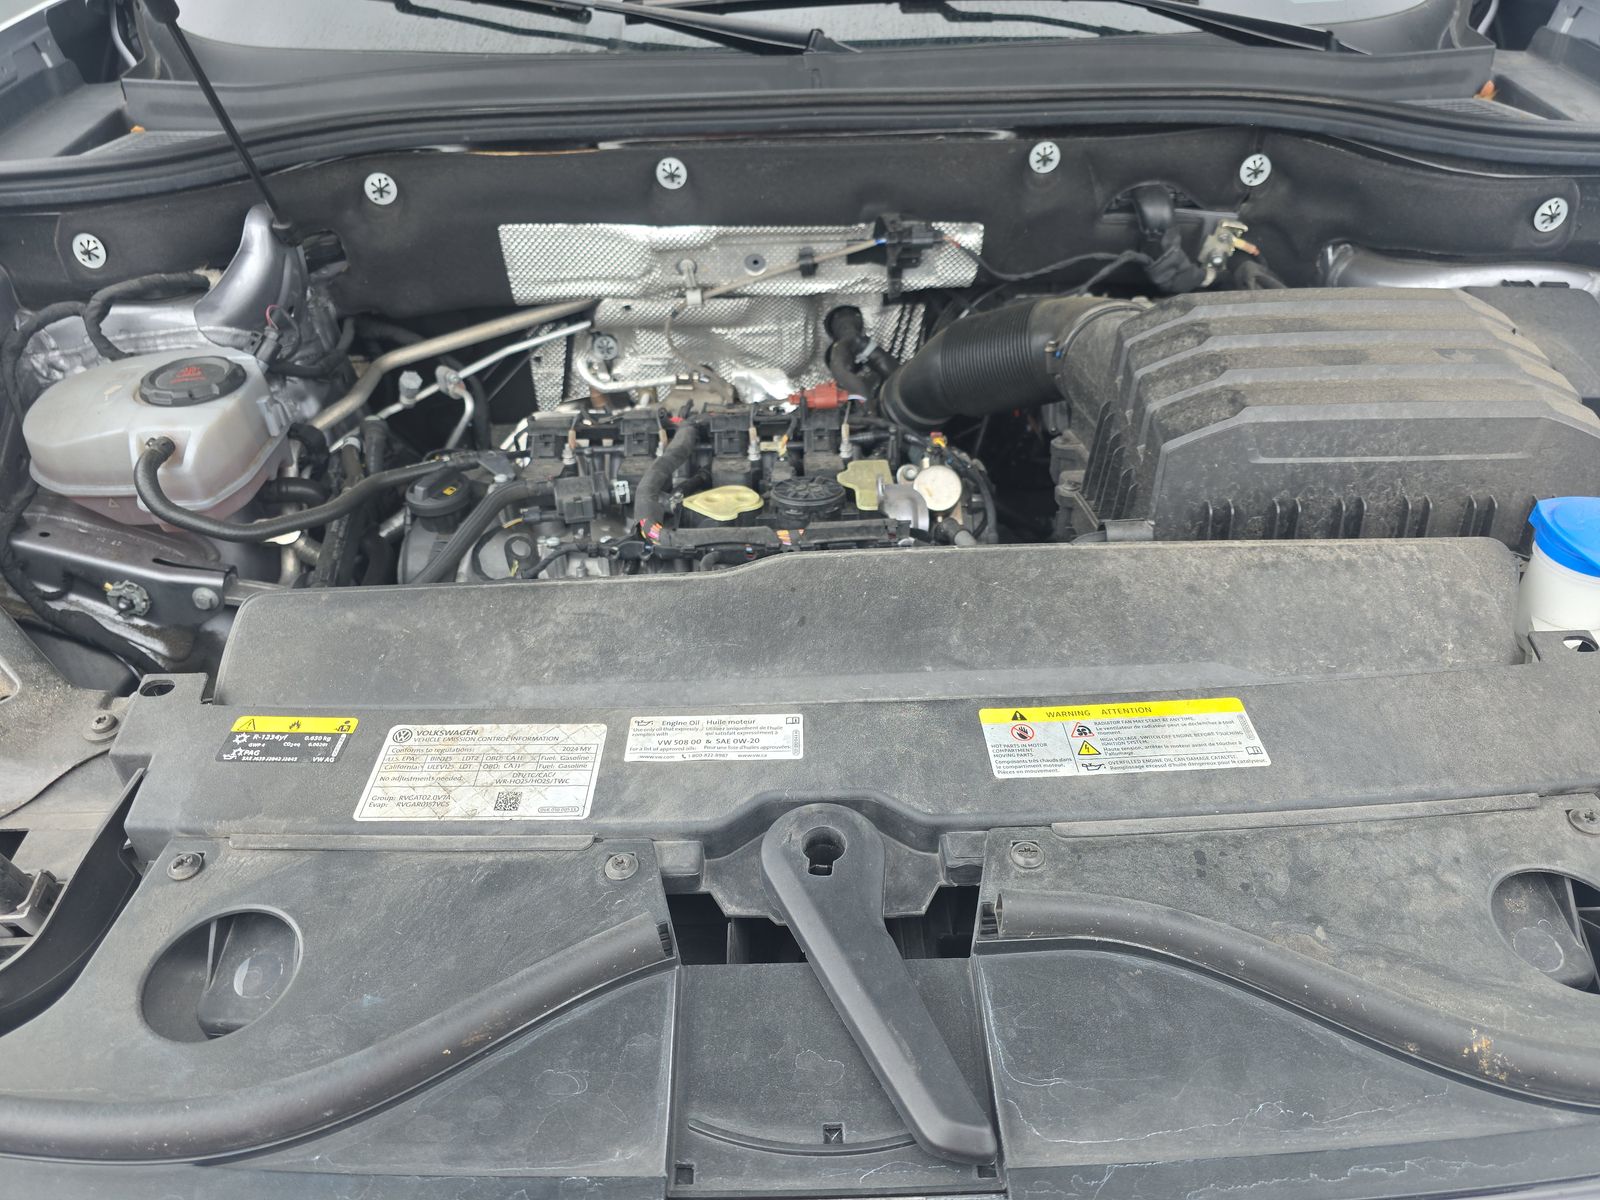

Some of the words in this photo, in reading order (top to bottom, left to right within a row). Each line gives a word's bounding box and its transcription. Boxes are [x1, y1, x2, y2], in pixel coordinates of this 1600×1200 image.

[1046, 710, 1091, 718] WARNING
[1101, 707, 1152, 715] ATTENTION
[252, 734, 288, 742] R-1234yf
